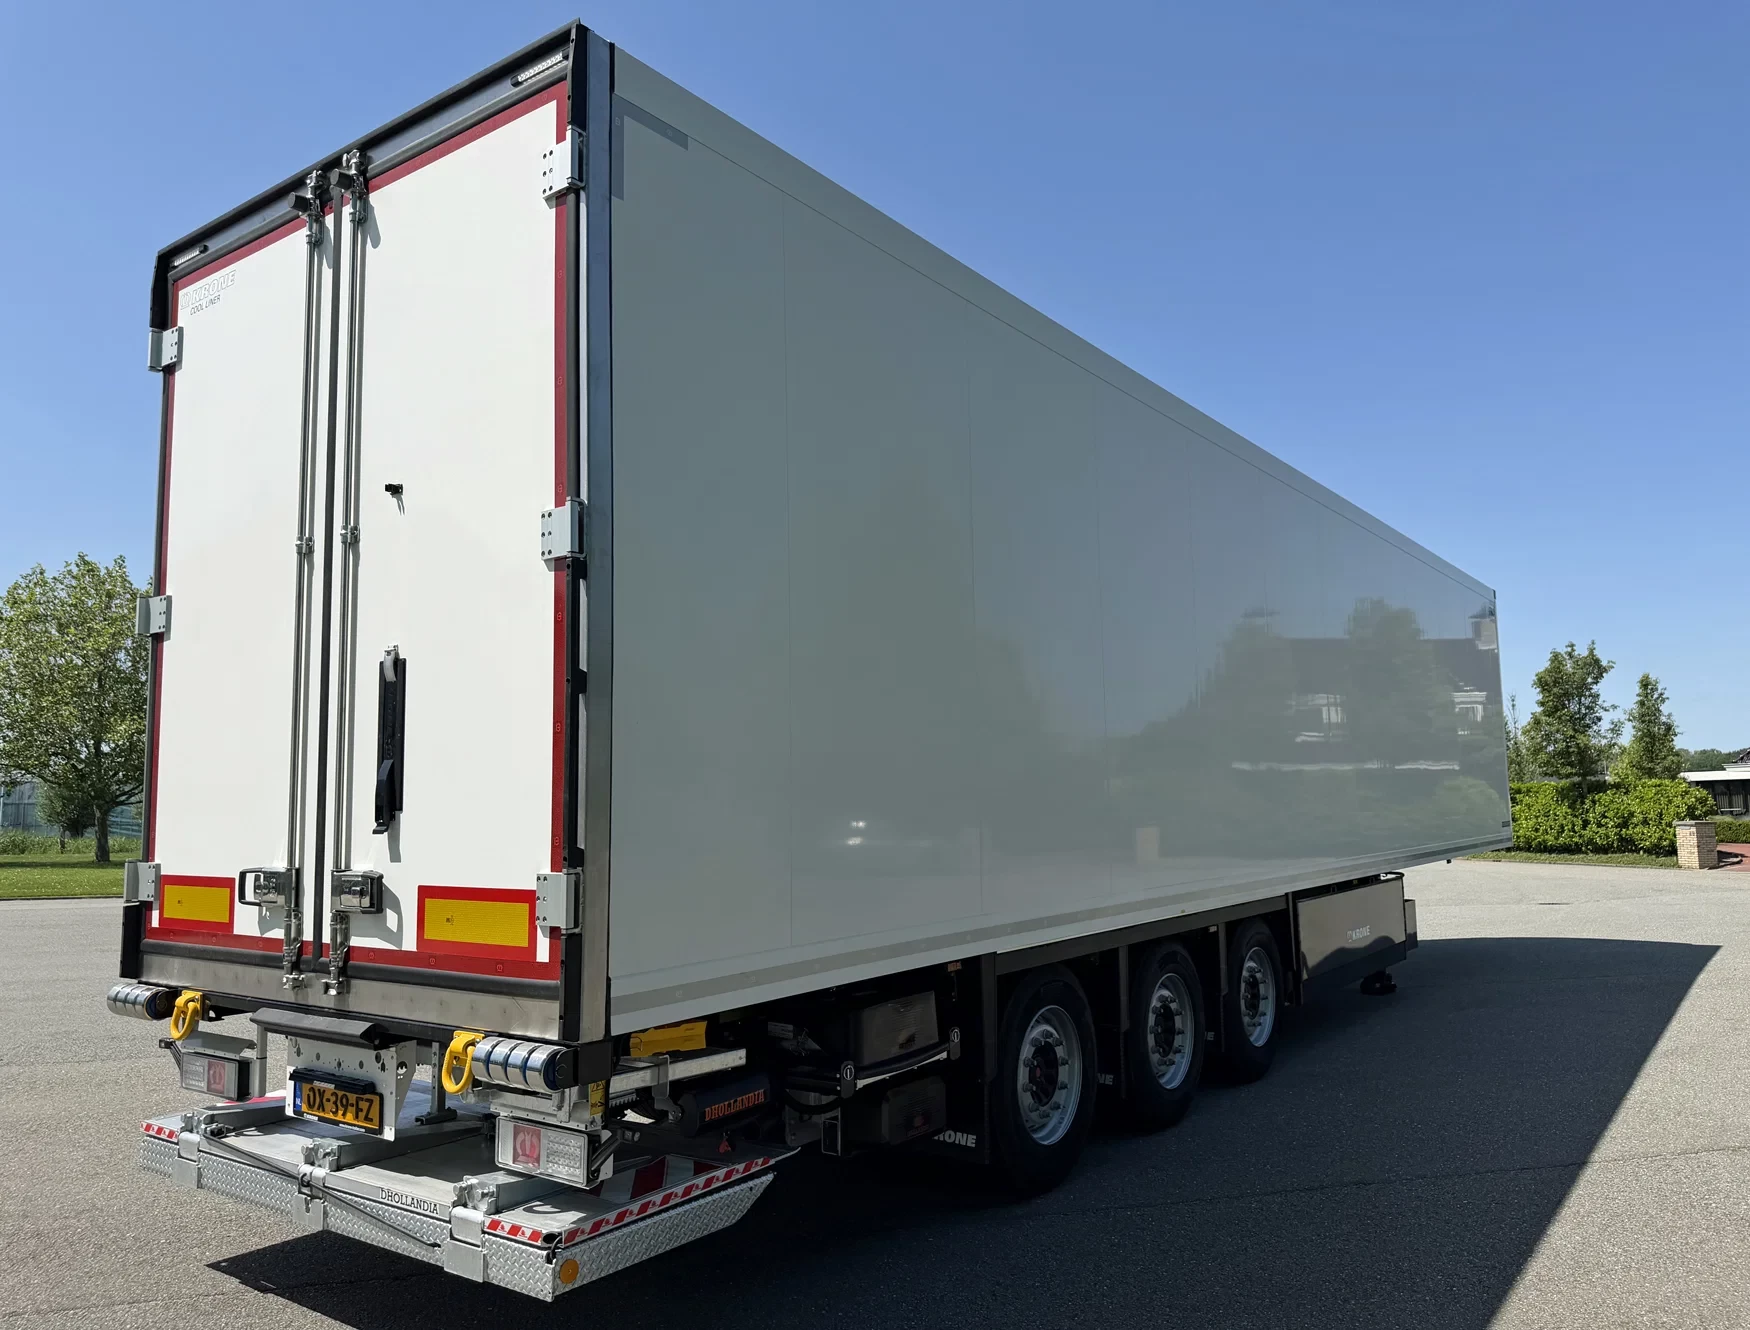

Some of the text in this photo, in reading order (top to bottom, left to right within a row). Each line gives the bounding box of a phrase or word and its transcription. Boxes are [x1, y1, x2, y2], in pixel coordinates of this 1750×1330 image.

[191, 269, 236, 305] KRONE
[190, 294, 221, 315] COOL LINER
[704, 1088, 765, 1121] DHOLLANDIA
[931, 1129, 977, 1148] ONE
[380, 1187, 439, 1215] DHOLLANDIA
